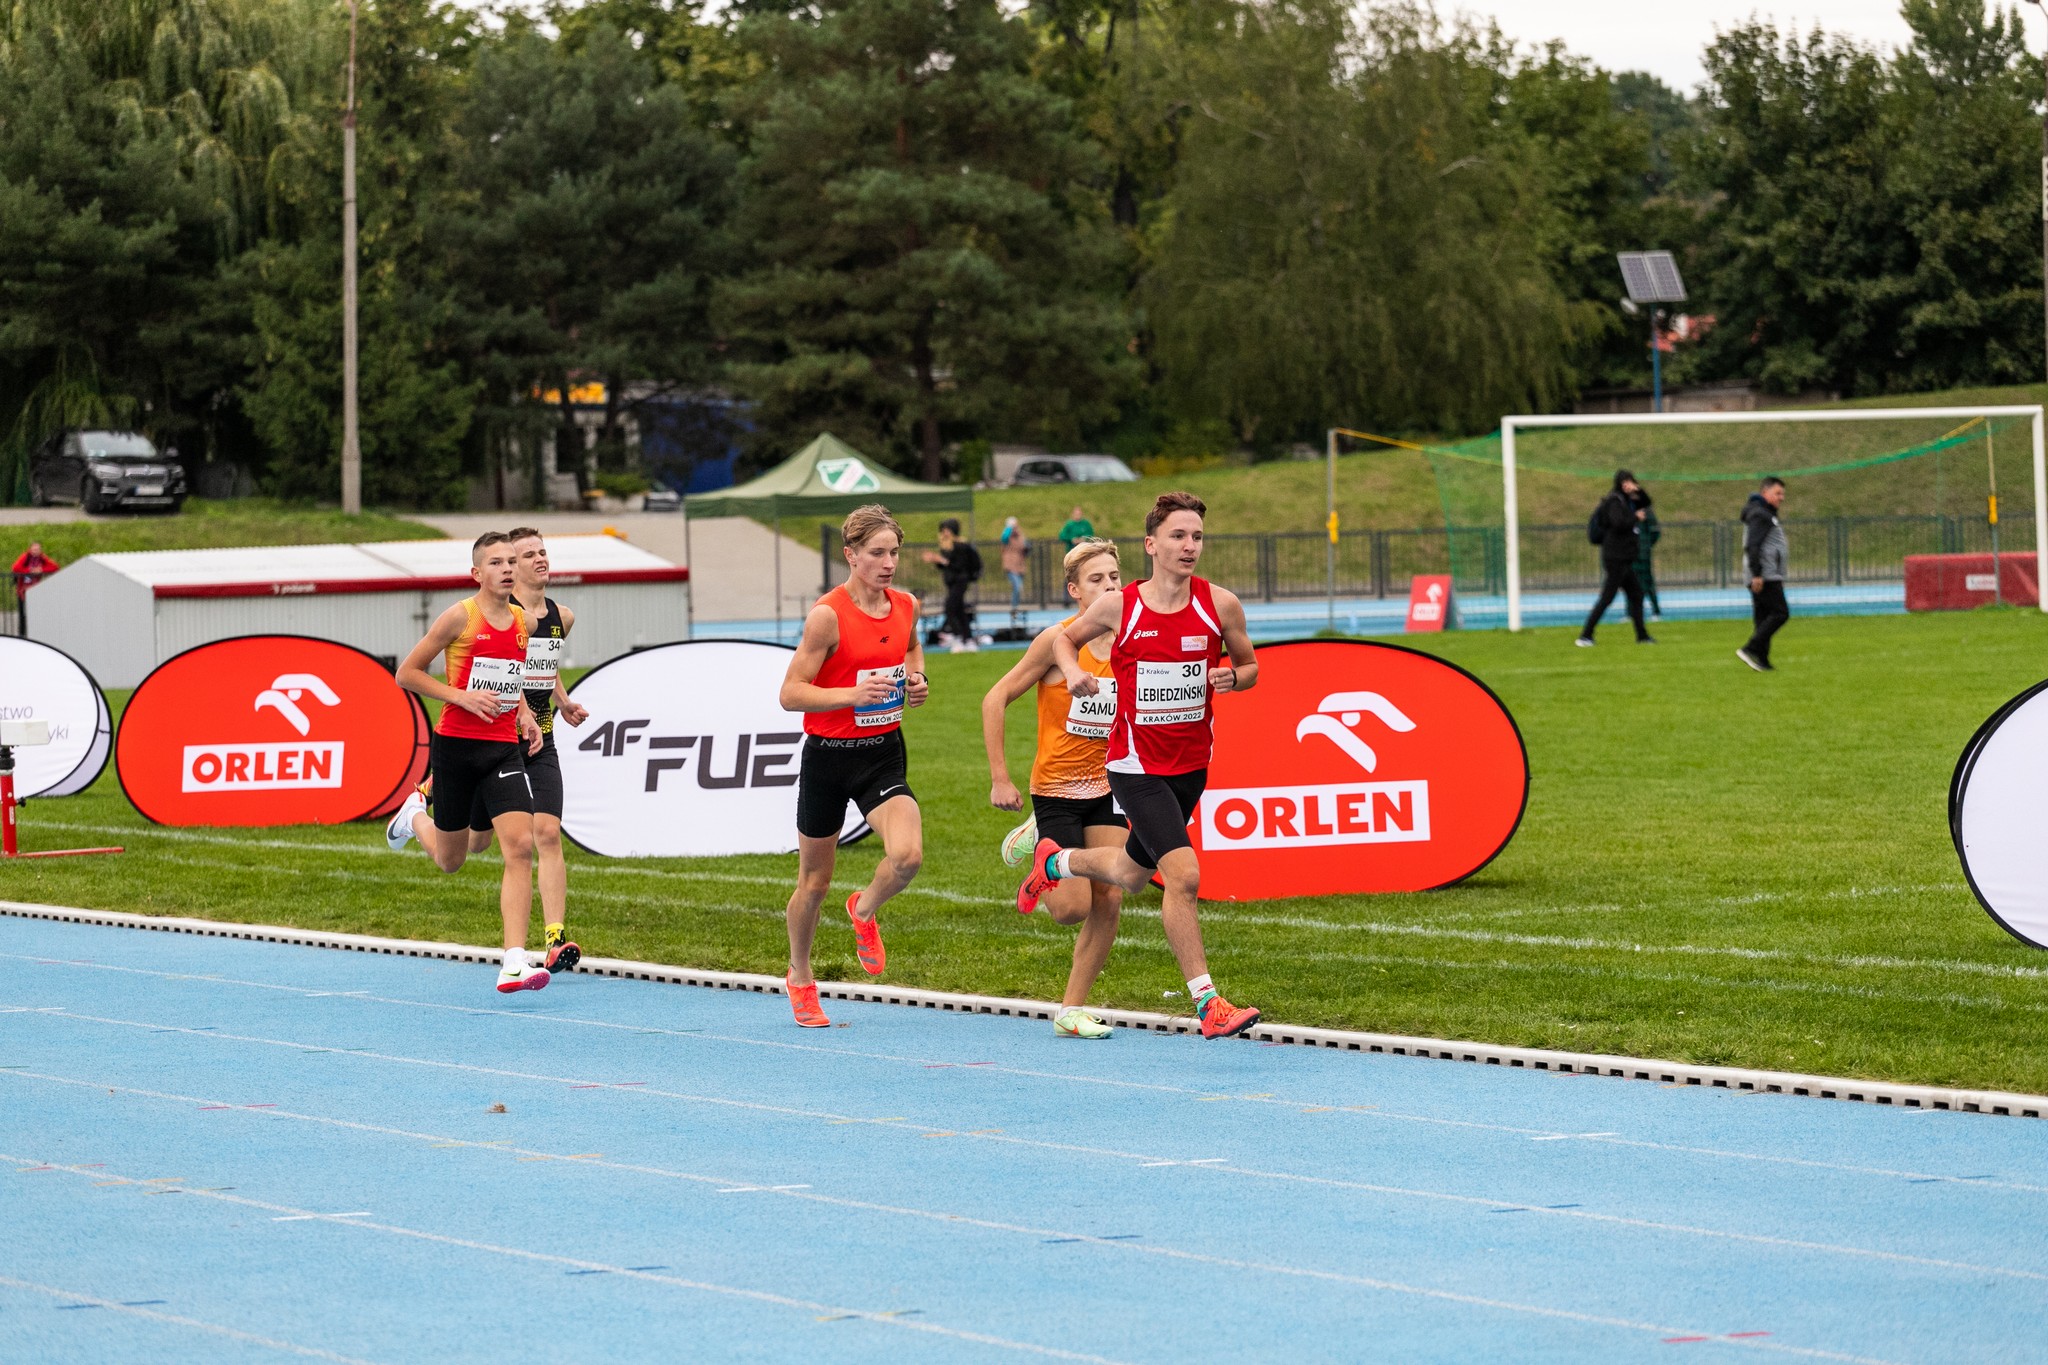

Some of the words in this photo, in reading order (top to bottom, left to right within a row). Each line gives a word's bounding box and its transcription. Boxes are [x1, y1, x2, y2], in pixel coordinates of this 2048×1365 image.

[548, 640, 561, 652] 34
[507, 662, 521, 676] 26
[892, 666, 905, 680] 46
[1146, 667, 1170, 675] Kraków
[1181, 663, 1202, 678] 30
[472, 677, 522, 695] WINIARSKI
[521, 680, 545, 688] RAKÓW
[1110, 680, 1118, 694] 1
[1138, 684, 1206, 702] LEBIEDZIŃSKI
[1079, 701, 1117, 716] SAMU
[861, 715, 892, 725] KRAKÓW
[1142, 713, 1181, 723] KRAKÓW
[1183, 711, 1202, 720] 2022
[47, 723, 70, 745] yki
[1072, 725, 1105, 736] KRAKÓW
[820, 738, 856, 748] NIKE
[856, 736, 885, 748] PRO
[578, 719, 651, 758] 4F
[644, 732, 804, 793] FUE
[192, 750, 332, 784] ORLEN
[1214, 791, 1414, 841] ORLEN
